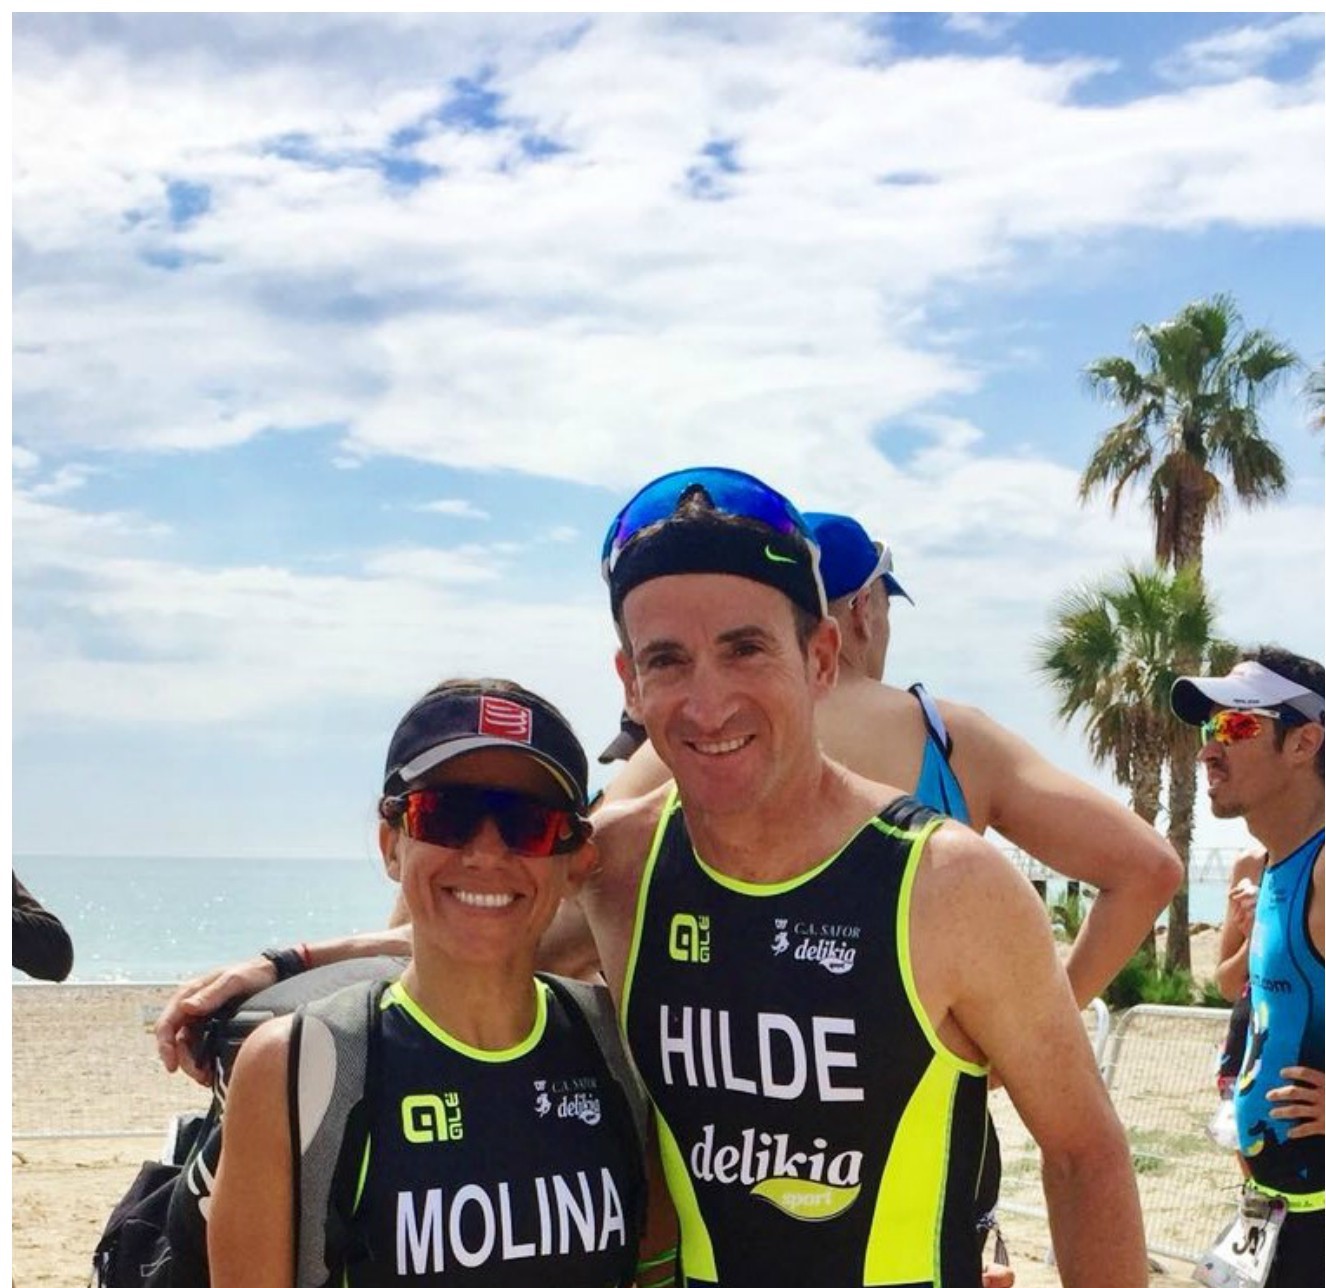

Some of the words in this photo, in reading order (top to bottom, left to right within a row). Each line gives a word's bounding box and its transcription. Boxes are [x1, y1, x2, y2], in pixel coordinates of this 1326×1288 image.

[794, 937, 857, 964] delikia
[660, 1004, 865, 1102] HILDE
[691, 1123, 864, 1186] delikia
[396, 1167, 626, 1276] MOLINA
